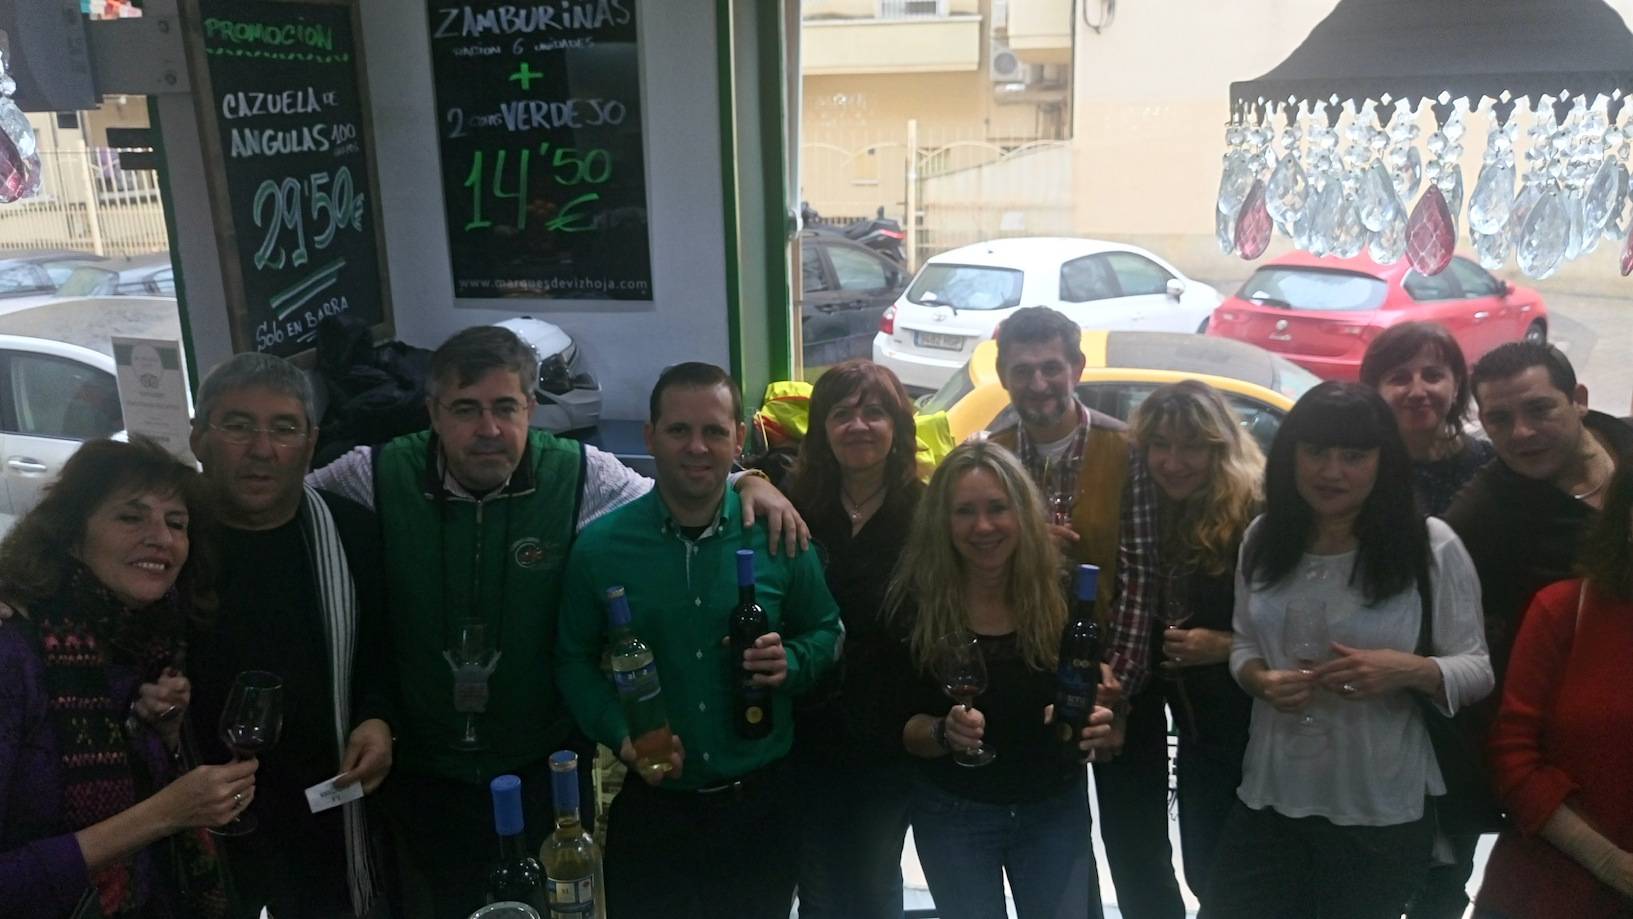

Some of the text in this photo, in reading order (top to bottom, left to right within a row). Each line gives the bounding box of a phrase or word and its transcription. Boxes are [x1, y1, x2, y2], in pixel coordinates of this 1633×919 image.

[512, 37, 524, 55] 6
[222, 86, 321, 119] CAZUELA
[447, 107, 466, 138] 2
[500, 99, 627, 132] VERDEJO
[231, 123, 330, 158] ANGULAS
[331, 123, 356, 145] 100
[544, 193, 600, 233] €
[459, 276, 648, 293] www.marquesdevizhoja.com
[286, 320, 304, 336] EN
[304, 296, 349, 329] BARRA
